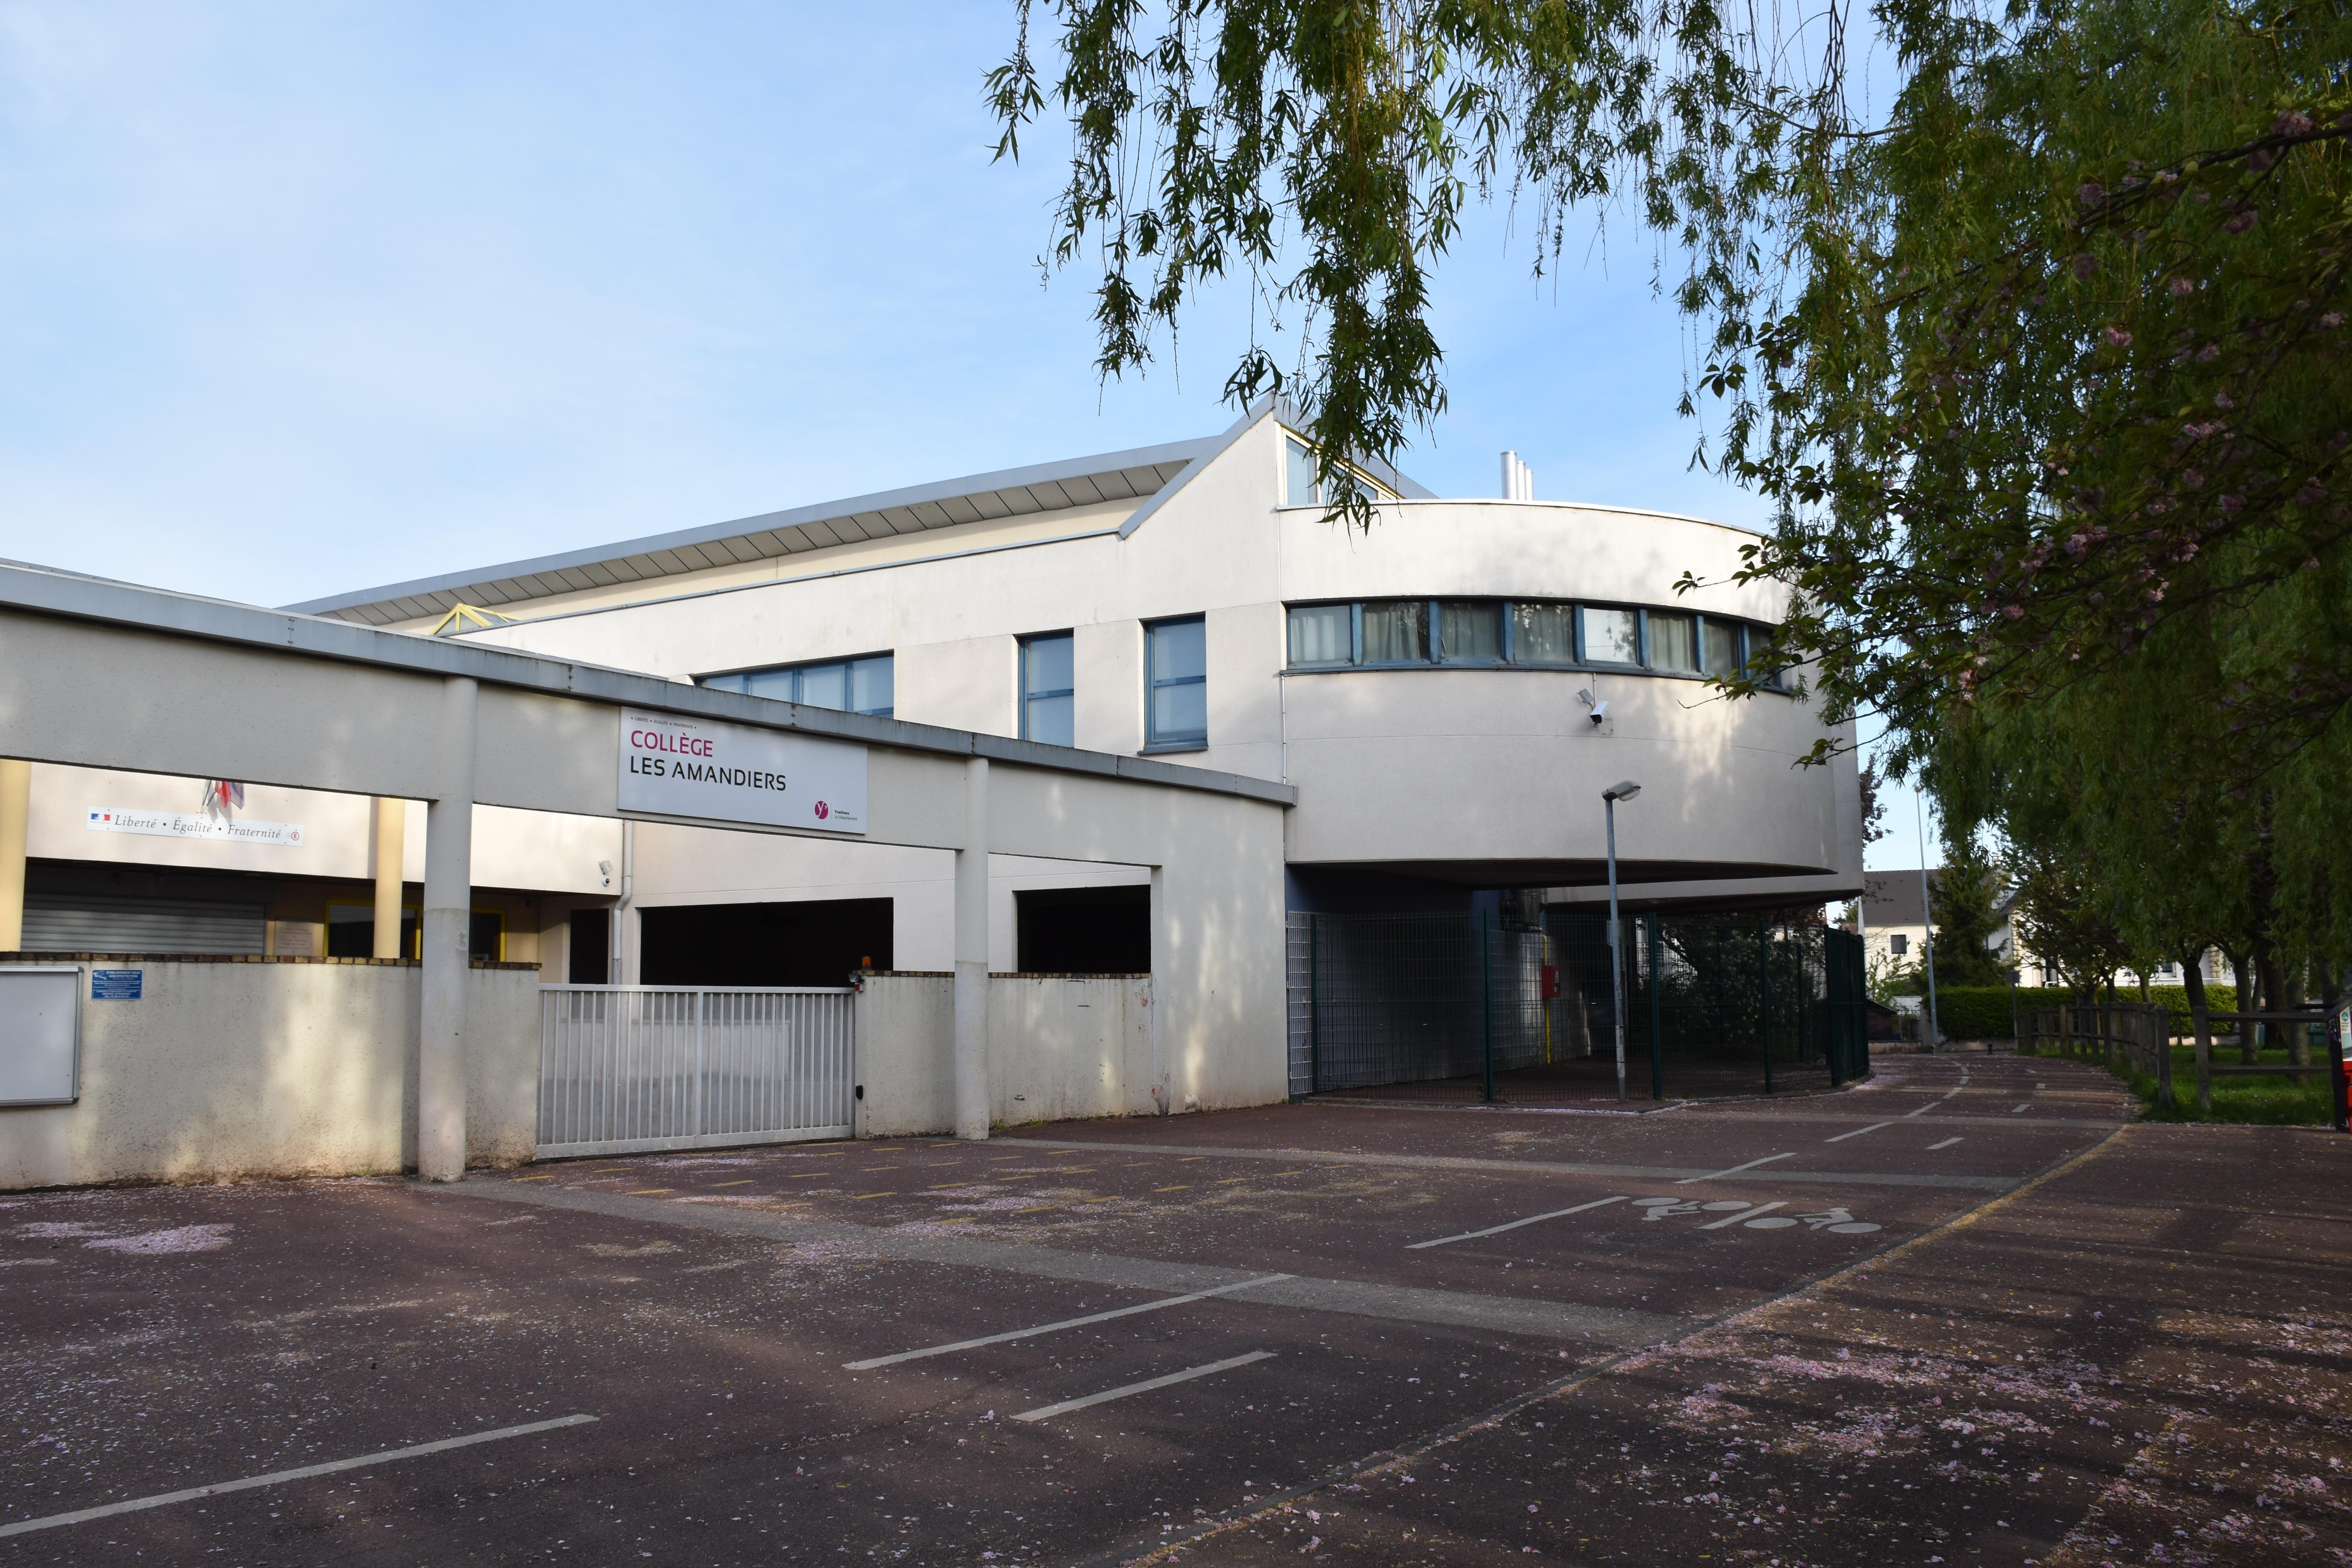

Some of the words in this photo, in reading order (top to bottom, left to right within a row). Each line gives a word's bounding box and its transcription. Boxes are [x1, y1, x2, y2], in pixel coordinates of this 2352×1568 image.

[631, 730, 713, 757] COLLÈGE
[631, 756, 665, 777] LES
[671, 761, 786, 791] AMANDIERS
[115, 815, 157, 828] Liberté
[173, 817, 212, 834] Égalité
[228, 824, 281, 838] Fraternité
